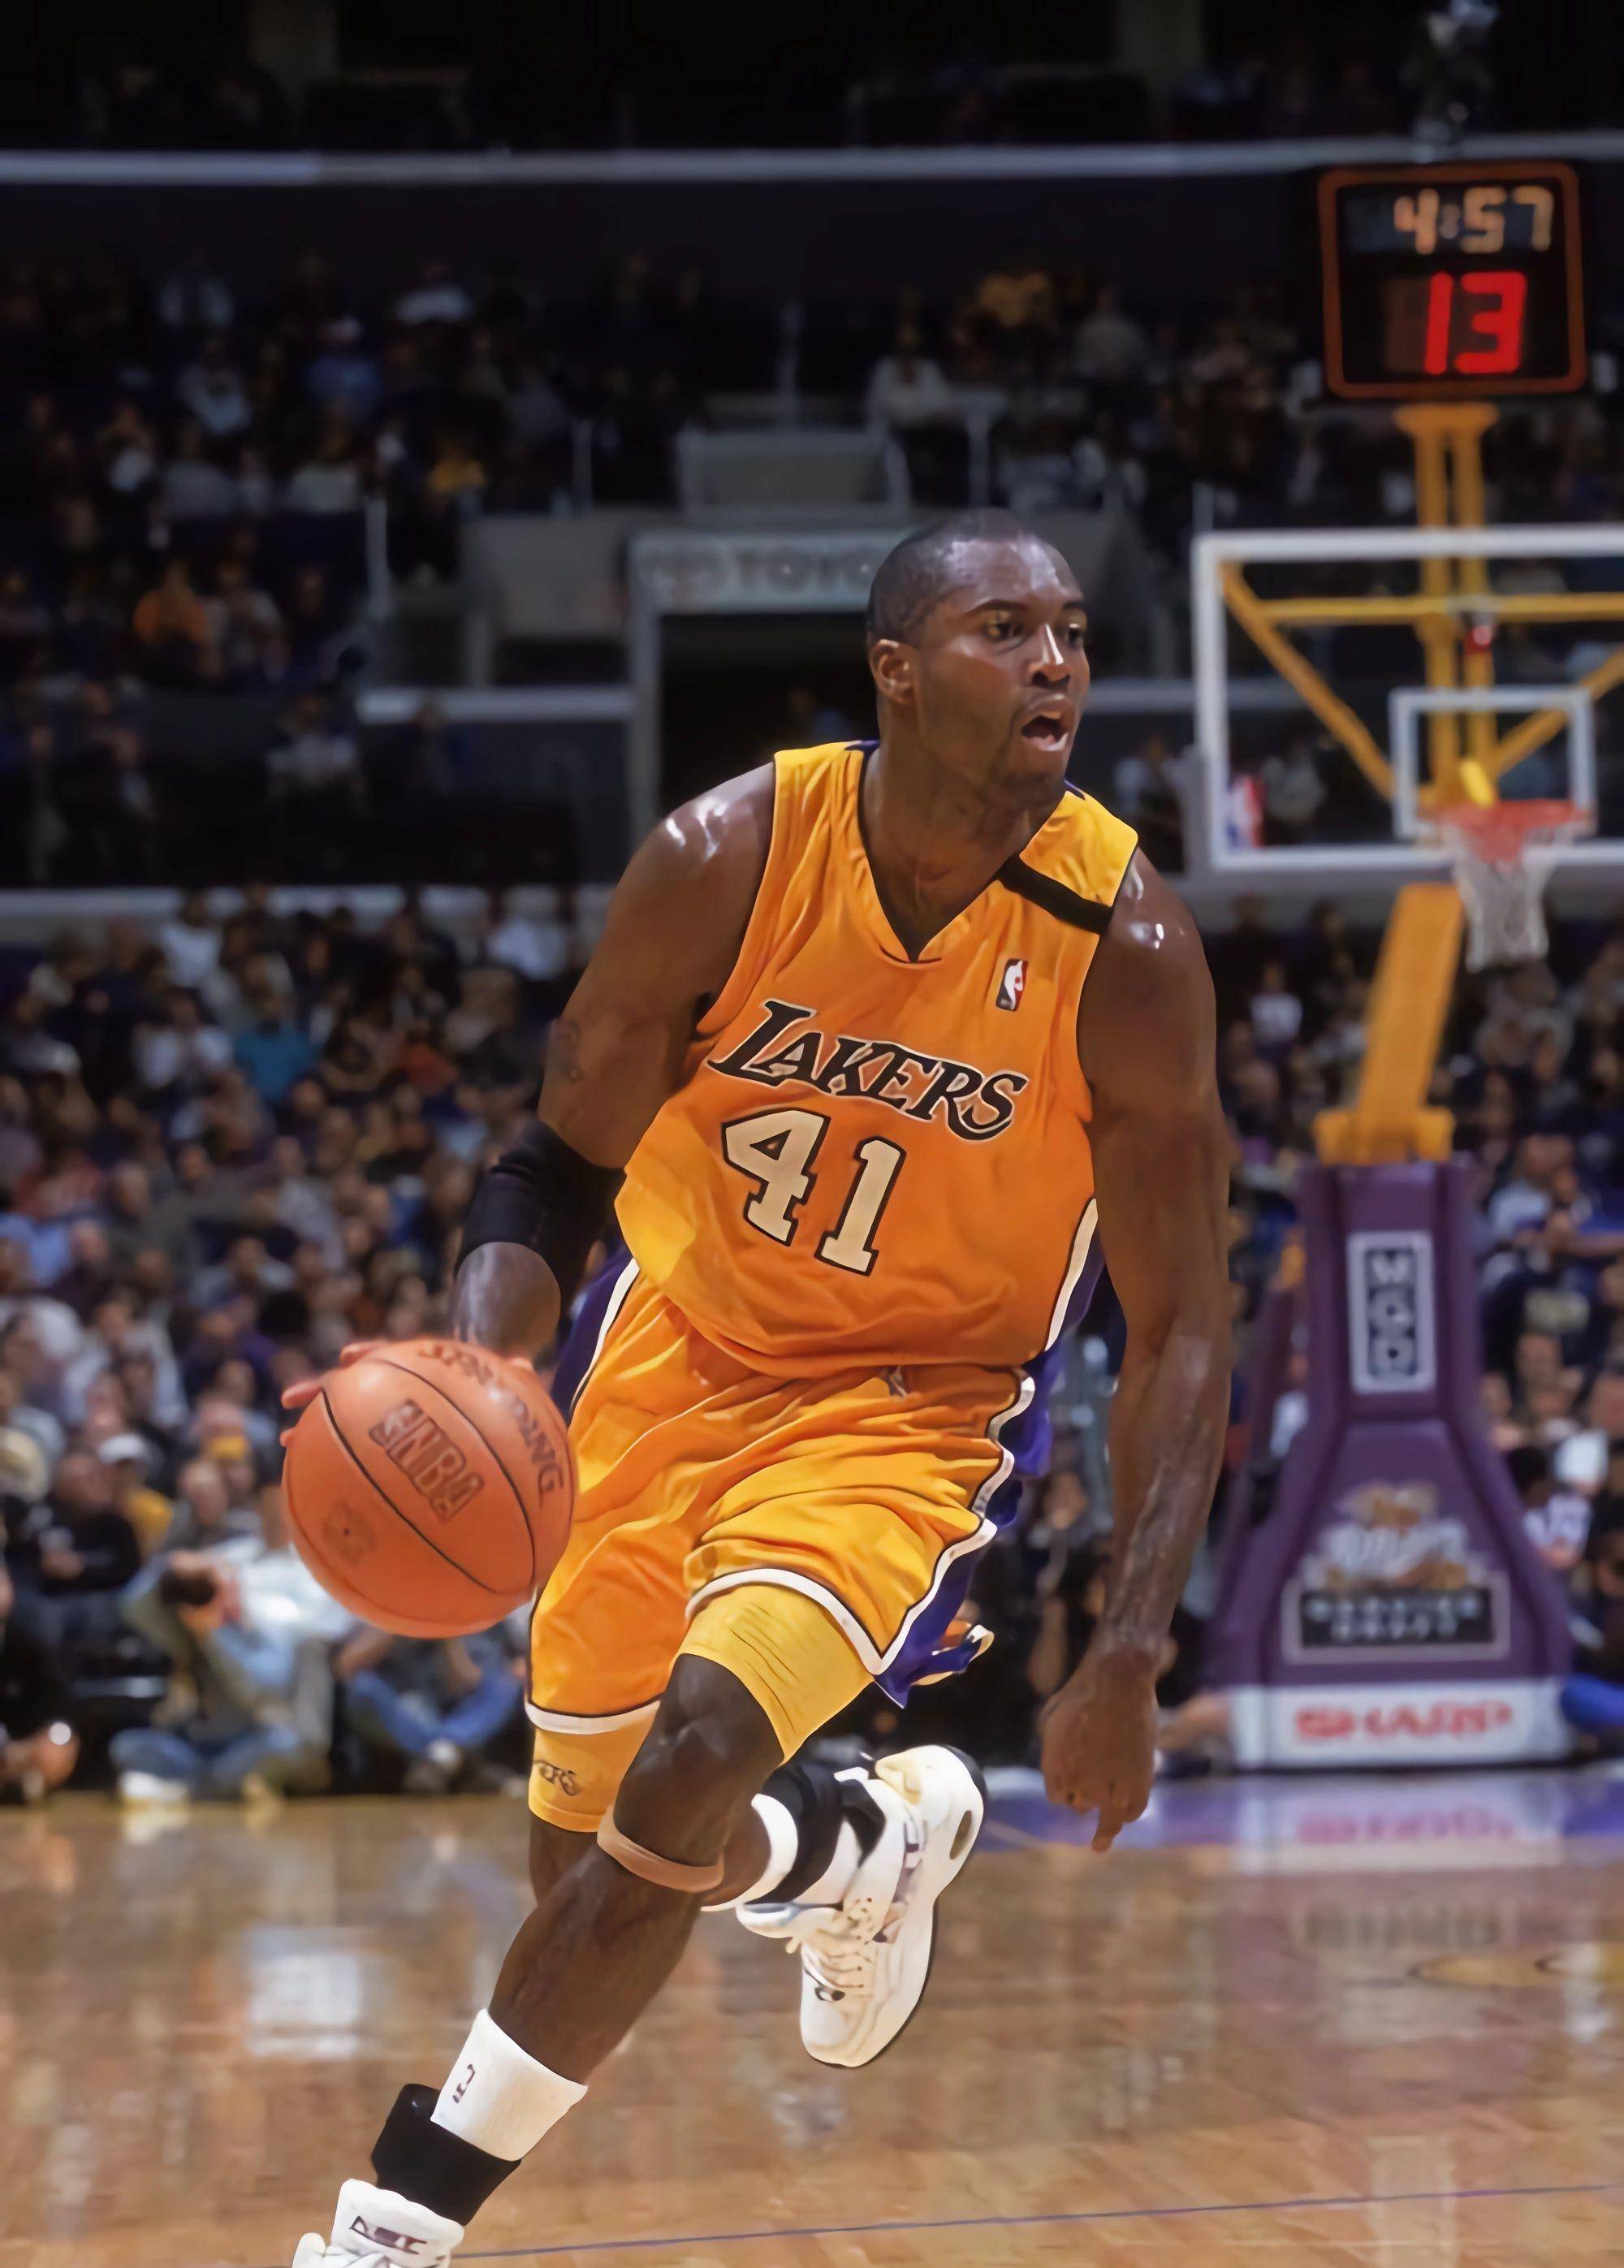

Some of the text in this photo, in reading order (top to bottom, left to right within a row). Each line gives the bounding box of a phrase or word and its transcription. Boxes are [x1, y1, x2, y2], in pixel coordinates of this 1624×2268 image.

[1393, 187, 1553, 255] 4:57
[1424, 271, 1527, 374] 13
[706, 999, 1029, 1143] LAKERS
[721, 1107, 907, 1277] 41
[385, 1410, 484, 1523] NBA
[417, 1345, 564, 1509] SPADING
[533, 1759, 582, 1796] ERS
